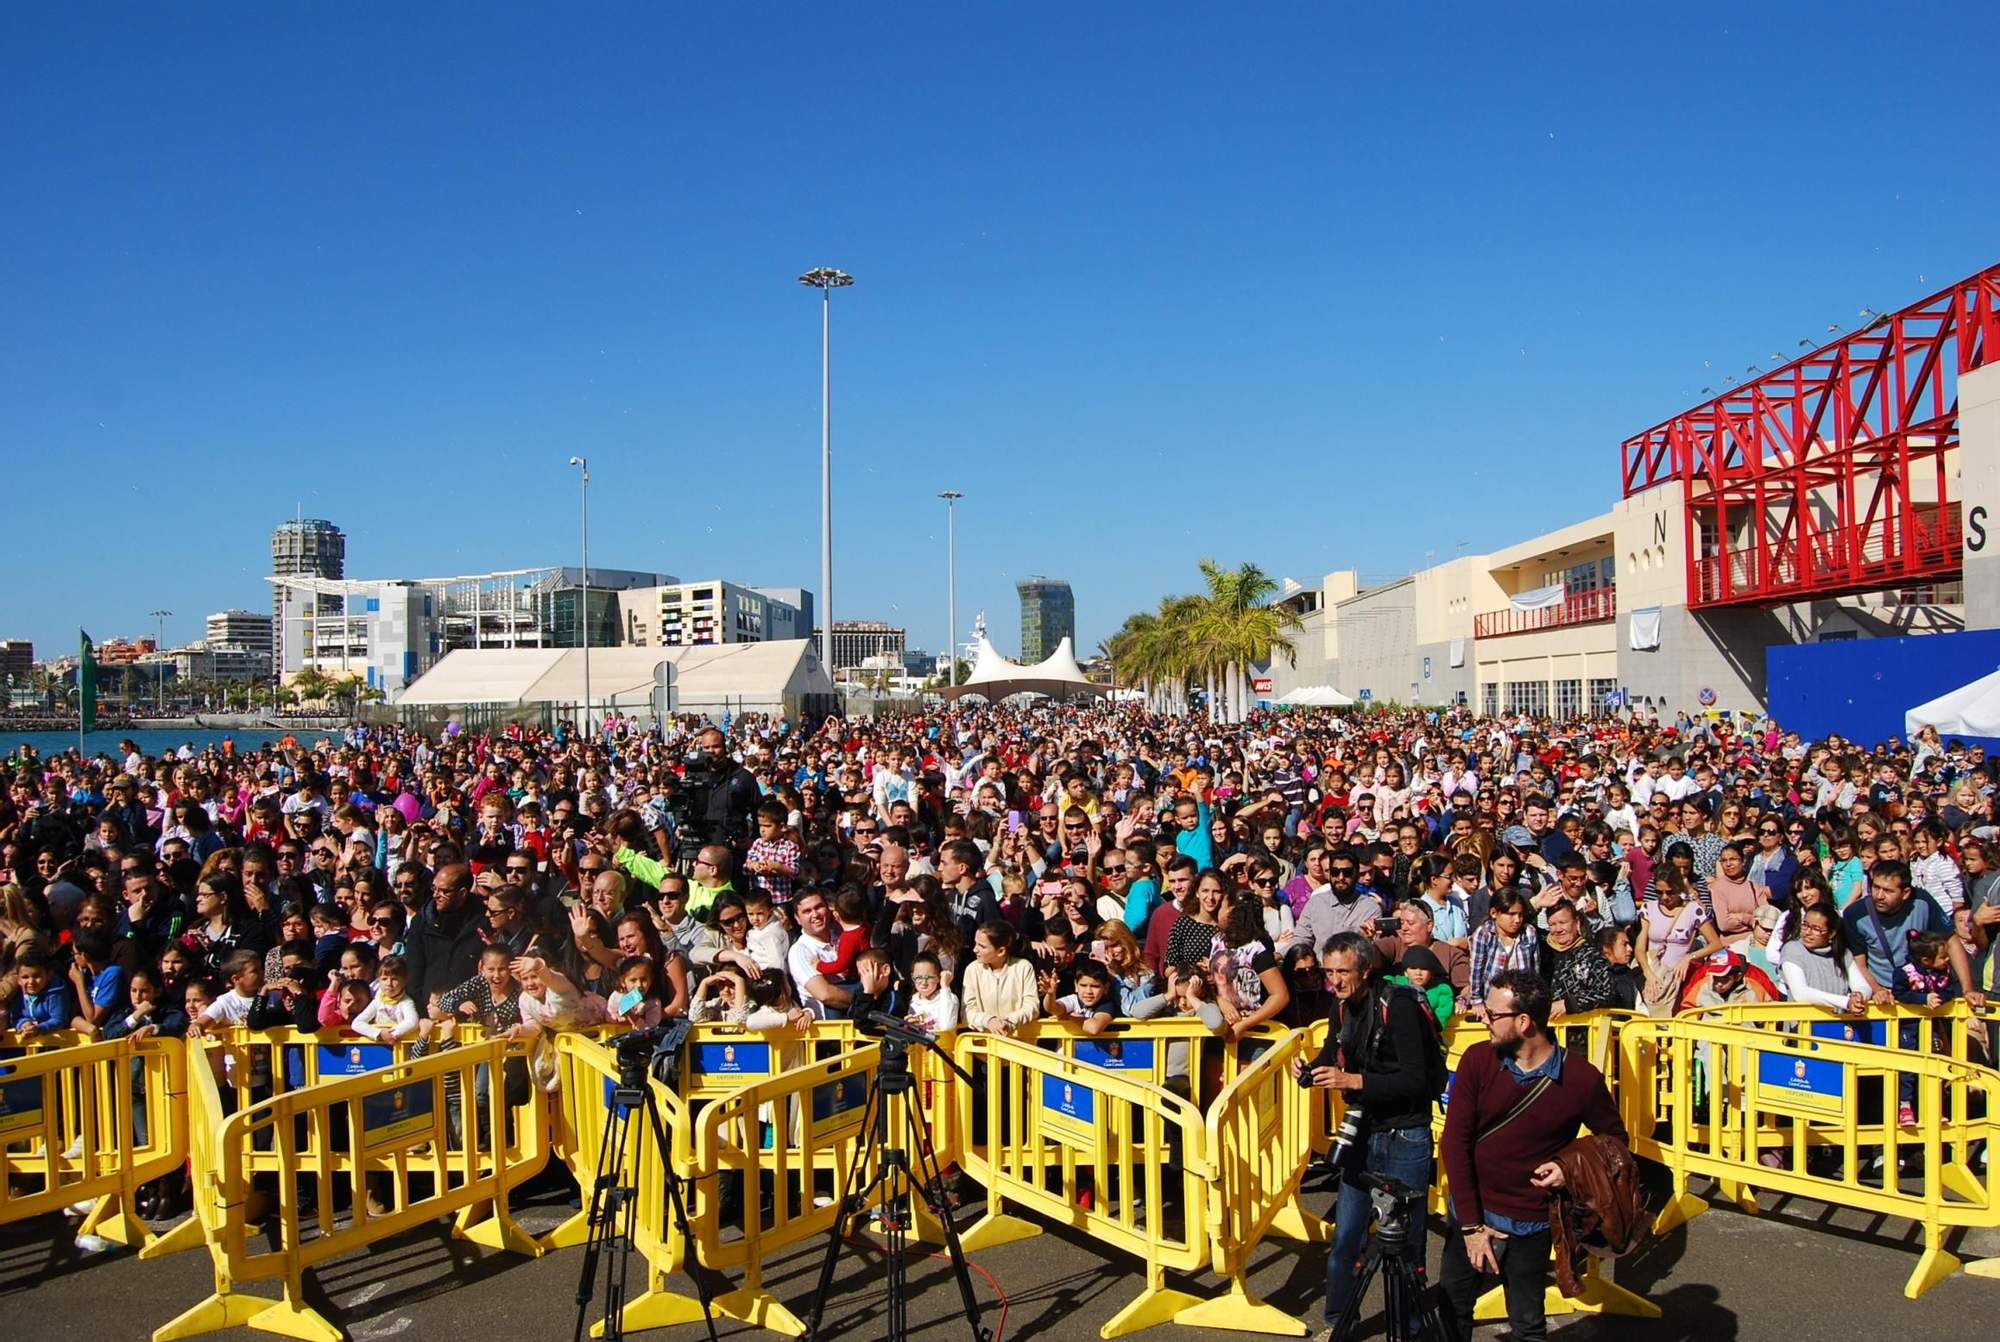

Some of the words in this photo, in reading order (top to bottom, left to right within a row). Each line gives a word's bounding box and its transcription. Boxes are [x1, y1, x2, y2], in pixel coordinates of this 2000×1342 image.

[1654, 510, 1666, 545] N
[1966, 506, 1987, 552] S
[1255, 681, 1271, 690] AVIS
[1785, 1090, 1814, 1099] DEPORTES
